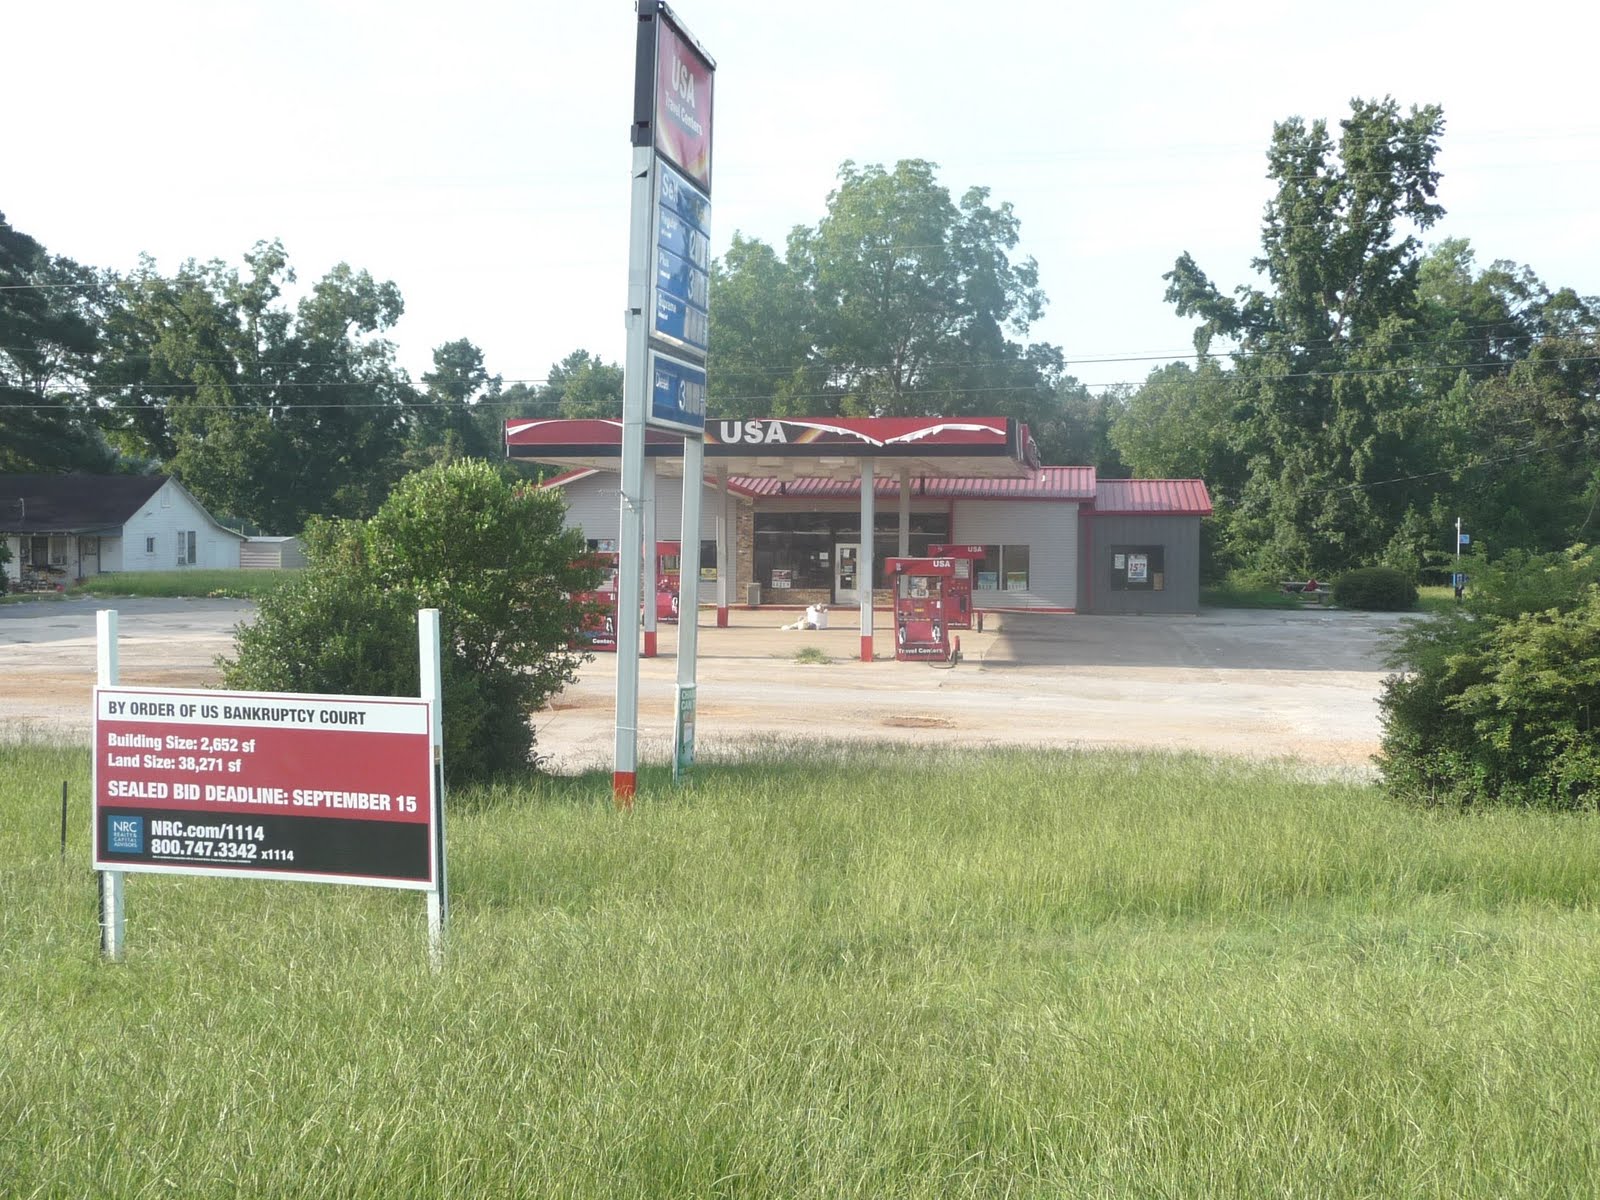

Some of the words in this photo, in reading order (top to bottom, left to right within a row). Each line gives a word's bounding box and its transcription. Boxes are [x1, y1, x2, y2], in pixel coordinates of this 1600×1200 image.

[672, 56, 695, 108] USA
[665, 90, 680, 118] Travel
[681, 107, 702, 136] Centers
[720, 421, 787, 443] USA
[933, 560, 951, 568] USA
[108, 701, 126, 714] BY
[131, 702, 175, 717] ORDER
[180, 704, 197, 718] OF
[202, 705, 219, 719] US
[224, 706, 315, 723] BANKRUPTCY
[320, 710, 366, 725] COURT
[108, 733, 162, 751] Building
[166, 735, 198, 750] Size:
[201, 737, 239, 753] 2,652
[242, 739, 256, 753] sf
[108, 753, 140, 768] Land
[144, 755, 175, 769] Size:
[178, 757, 223, 773] 38,271
[228, 759, 242, 773] sf
[108, 780, 168, 799] SEALED
[173, 783, 201, 800] BID
[205, 785, 289, 805] DEADLINE:
[292, 789, 391, 811] SEPTEMBER
[396, 796, 417, 812] 15
[113, 821, 137, 832] NRC
[151, 820, 264, 841] NRC.com/1114
[151, 839, 257, 859] 800.747.3342
[261, 849, 294, 861] x1114
